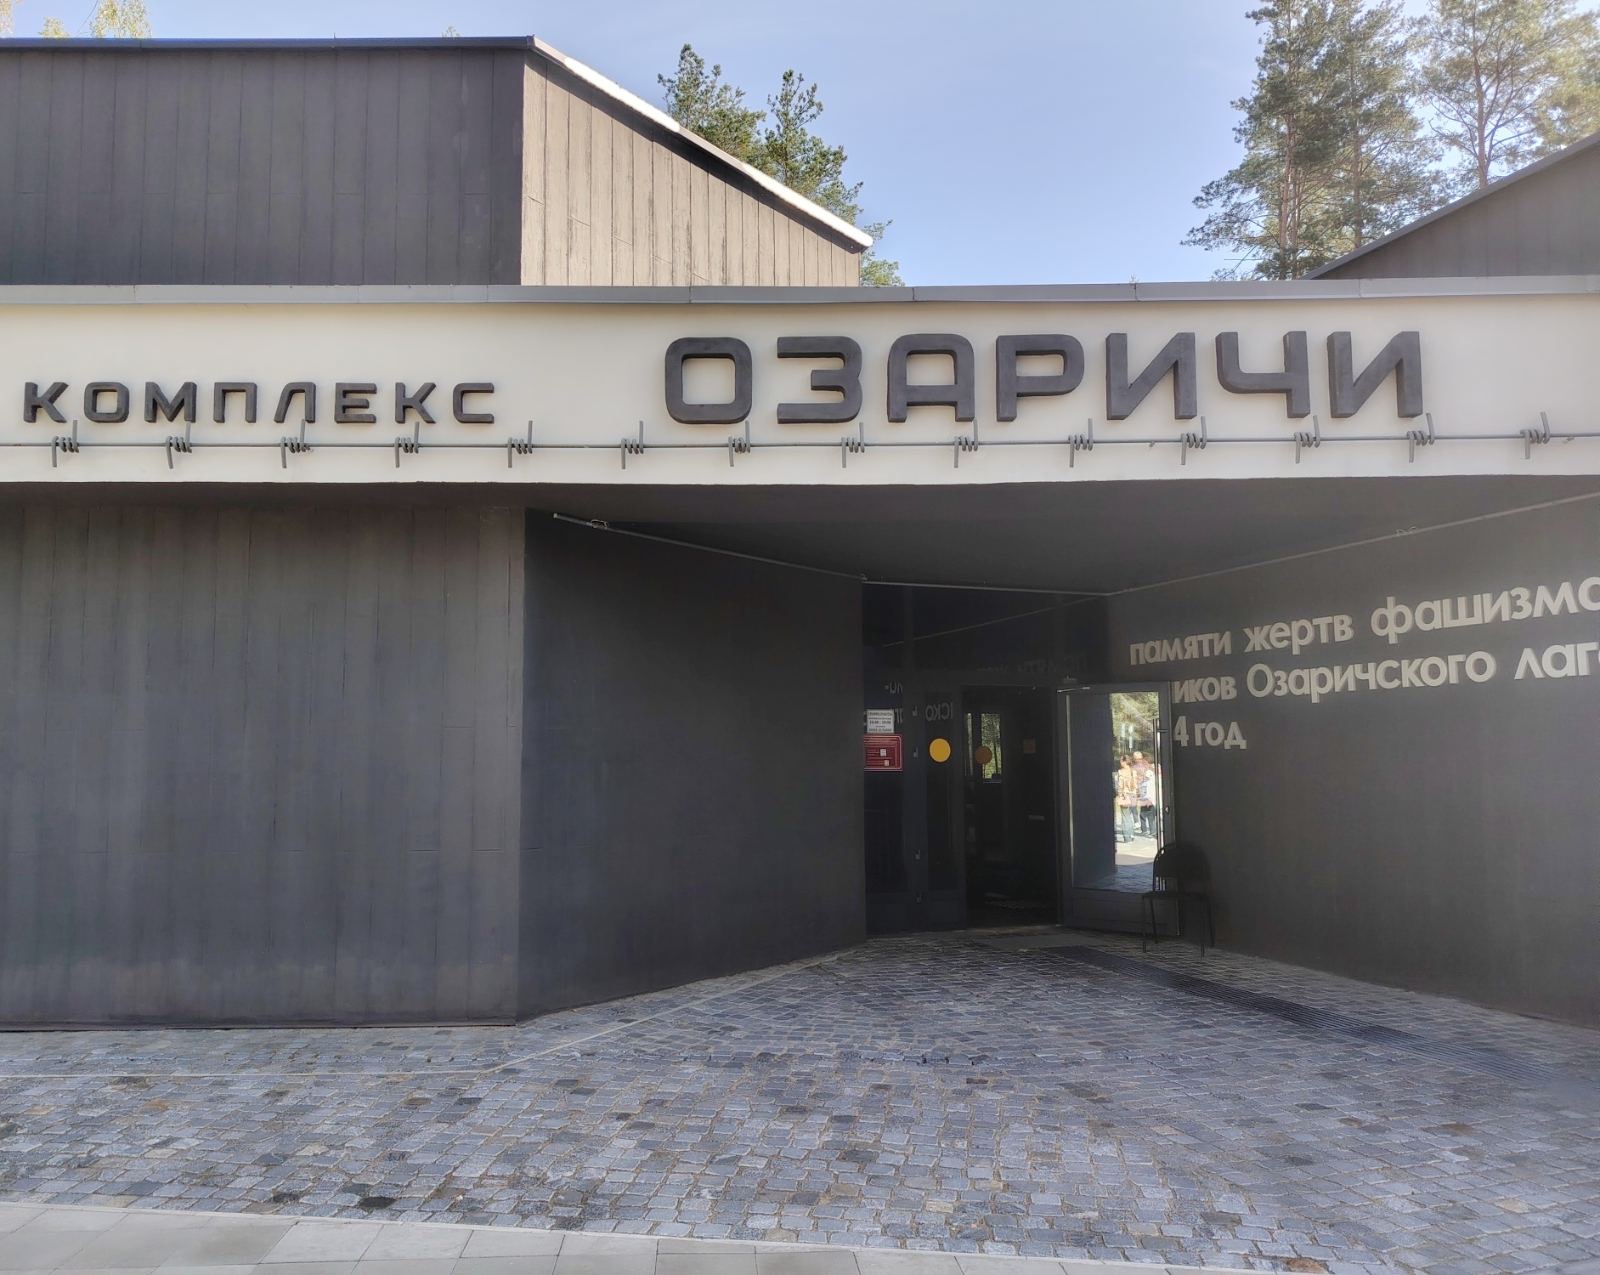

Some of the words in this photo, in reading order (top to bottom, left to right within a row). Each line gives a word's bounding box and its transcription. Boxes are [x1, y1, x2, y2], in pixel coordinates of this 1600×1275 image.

[23, 382, 495, 424] КОМПЛЕКС
[664, 330, 1424, 425] ОЗАРИЧИ
[1129, 630, 1233, 666] памяти
[1242, 614, 1354, 656] жертв
[1246, 650, 1498, 703] Озаричского
[1513, 641, 1600, 680] лаг
[1194, 721, 1248, 750] год
